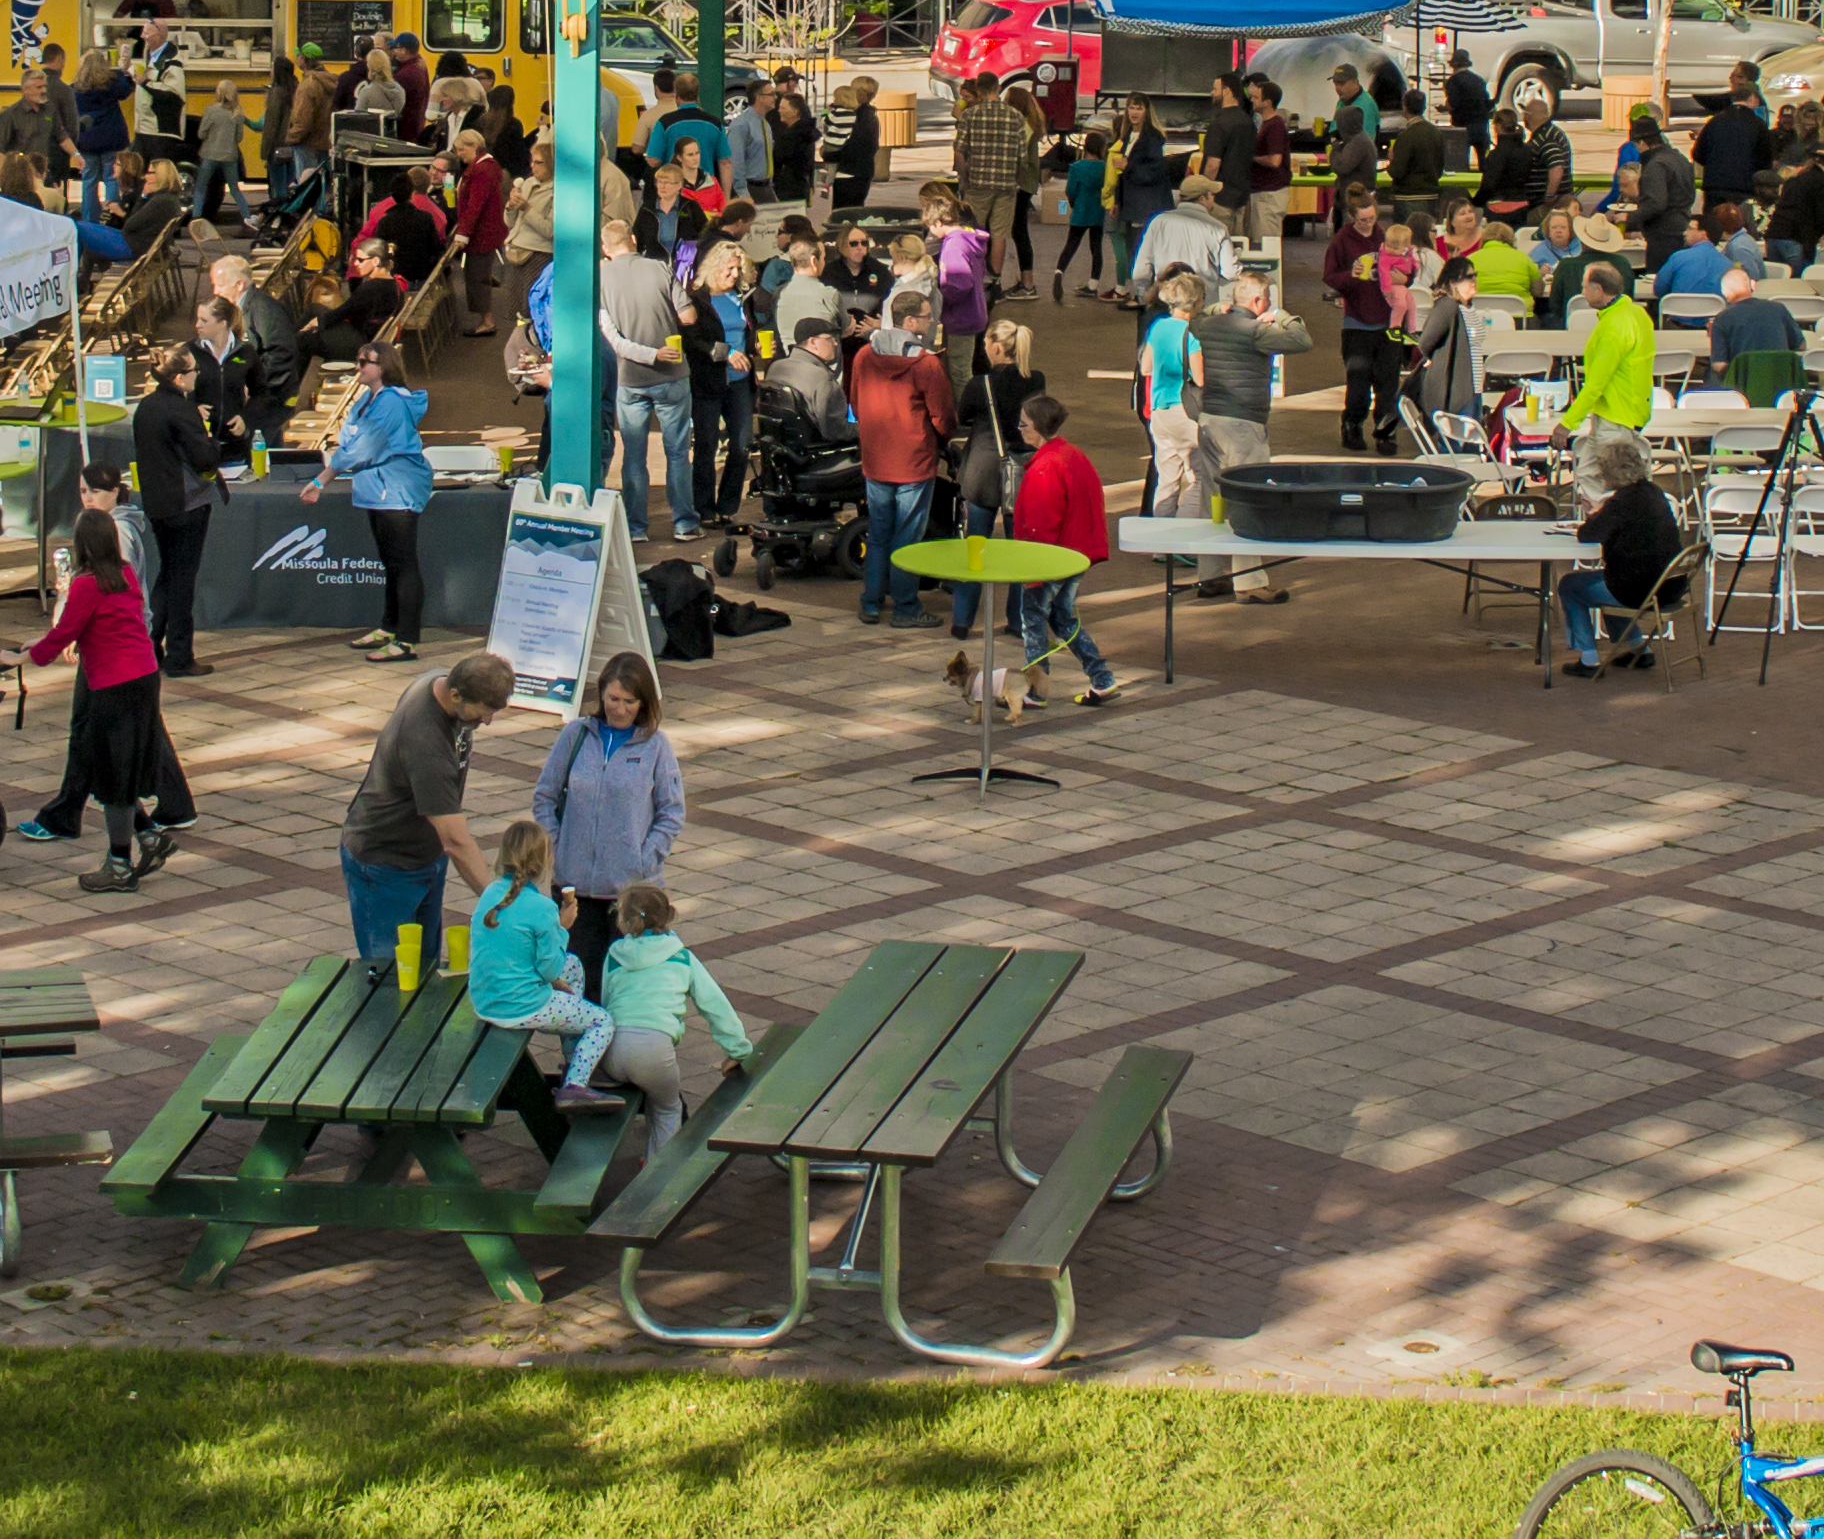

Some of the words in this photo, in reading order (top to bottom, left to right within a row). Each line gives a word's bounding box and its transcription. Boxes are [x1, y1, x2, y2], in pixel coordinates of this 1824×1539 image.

[9, 272, 63, 316] Meeting
[281, 557, 338, 570] Missoula
[342, 557, 385, 570] Federa
[537, 566, 562, 577] Agenda
[316, 572, 353, 585] Credit
